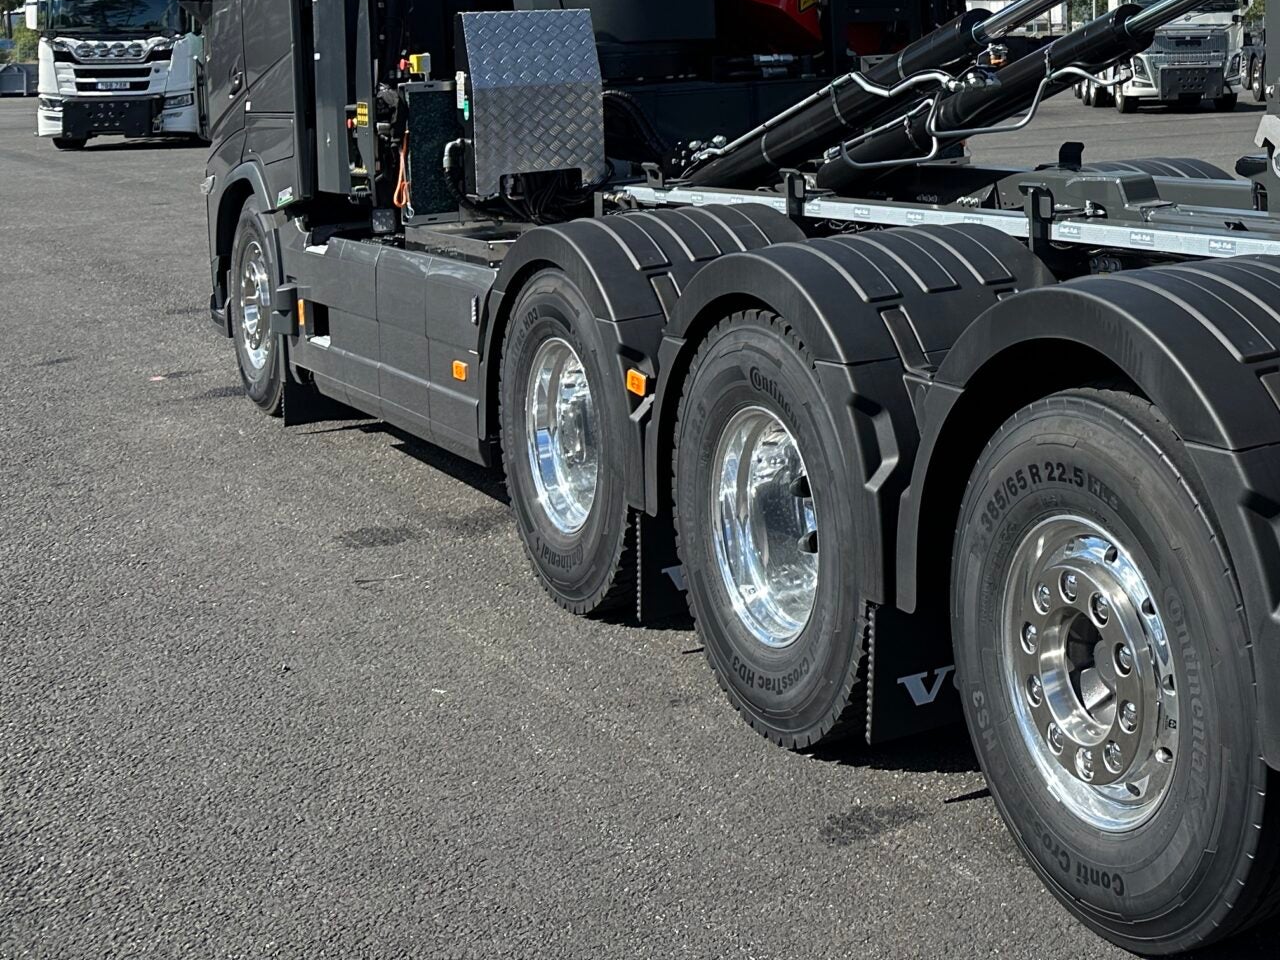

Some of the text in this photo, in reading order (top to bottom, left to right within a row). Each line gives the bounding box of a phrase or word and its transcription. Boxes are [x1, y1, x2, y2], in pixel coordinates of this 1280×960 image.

[980, 469, 1028, 532] 385/65
[1028, 463, 1042, 484] R
[1044, 461, 1084, 488] 22.5
[732, 655, 756, 689] HD3
[758, 656, 810, 696] CrossTrac
[972, 689, 997, 752] HS3
[1076, 862, 1126, 896] Conti
